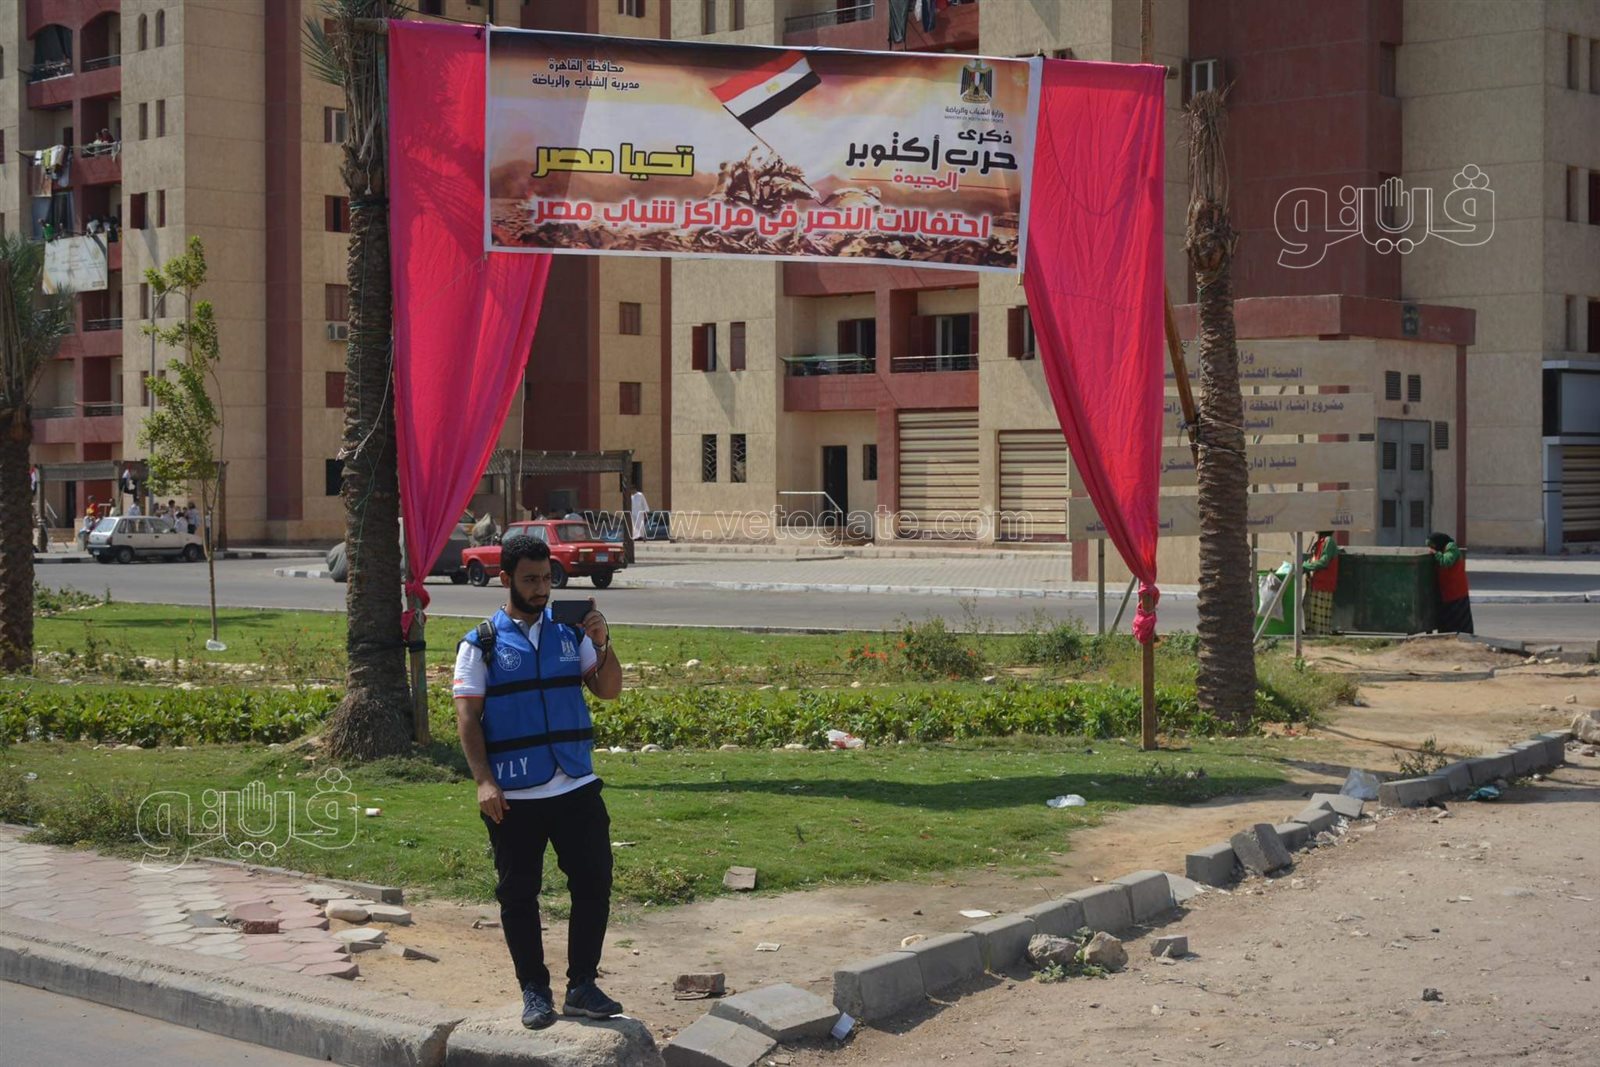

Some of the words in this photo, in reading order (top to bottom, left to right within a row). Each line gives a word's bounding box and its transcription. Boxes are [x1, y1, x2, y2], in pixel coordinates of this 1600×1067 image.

[548, 58, 582, 72] القاهرة
[586, 60, 624, 73] محافظة
[532, 73, 570, 88] والرياضة
[574, 76, 608, 90] الشباب
[611, 77, 640, 91] مديرية
[957, 129, 1013, 145] ذكرى
[531, 146, 614, 178] مصر
[619, 142, 695, 181] تحيا
[845, 131, 940, 171] أكتوبر
[945, 148, 1018, 175] حرب
[893, 168, 958, 191] المجيدة
[534, 200, 593, 225] مصر
[603, 199, 675, 229] شباب
[681, 201, 754, 231] مراكز
[803, 206, 872, 232] النصر
[877, 207, 990, 238] احتفالات
[496, 756, 529, 779] YLY
